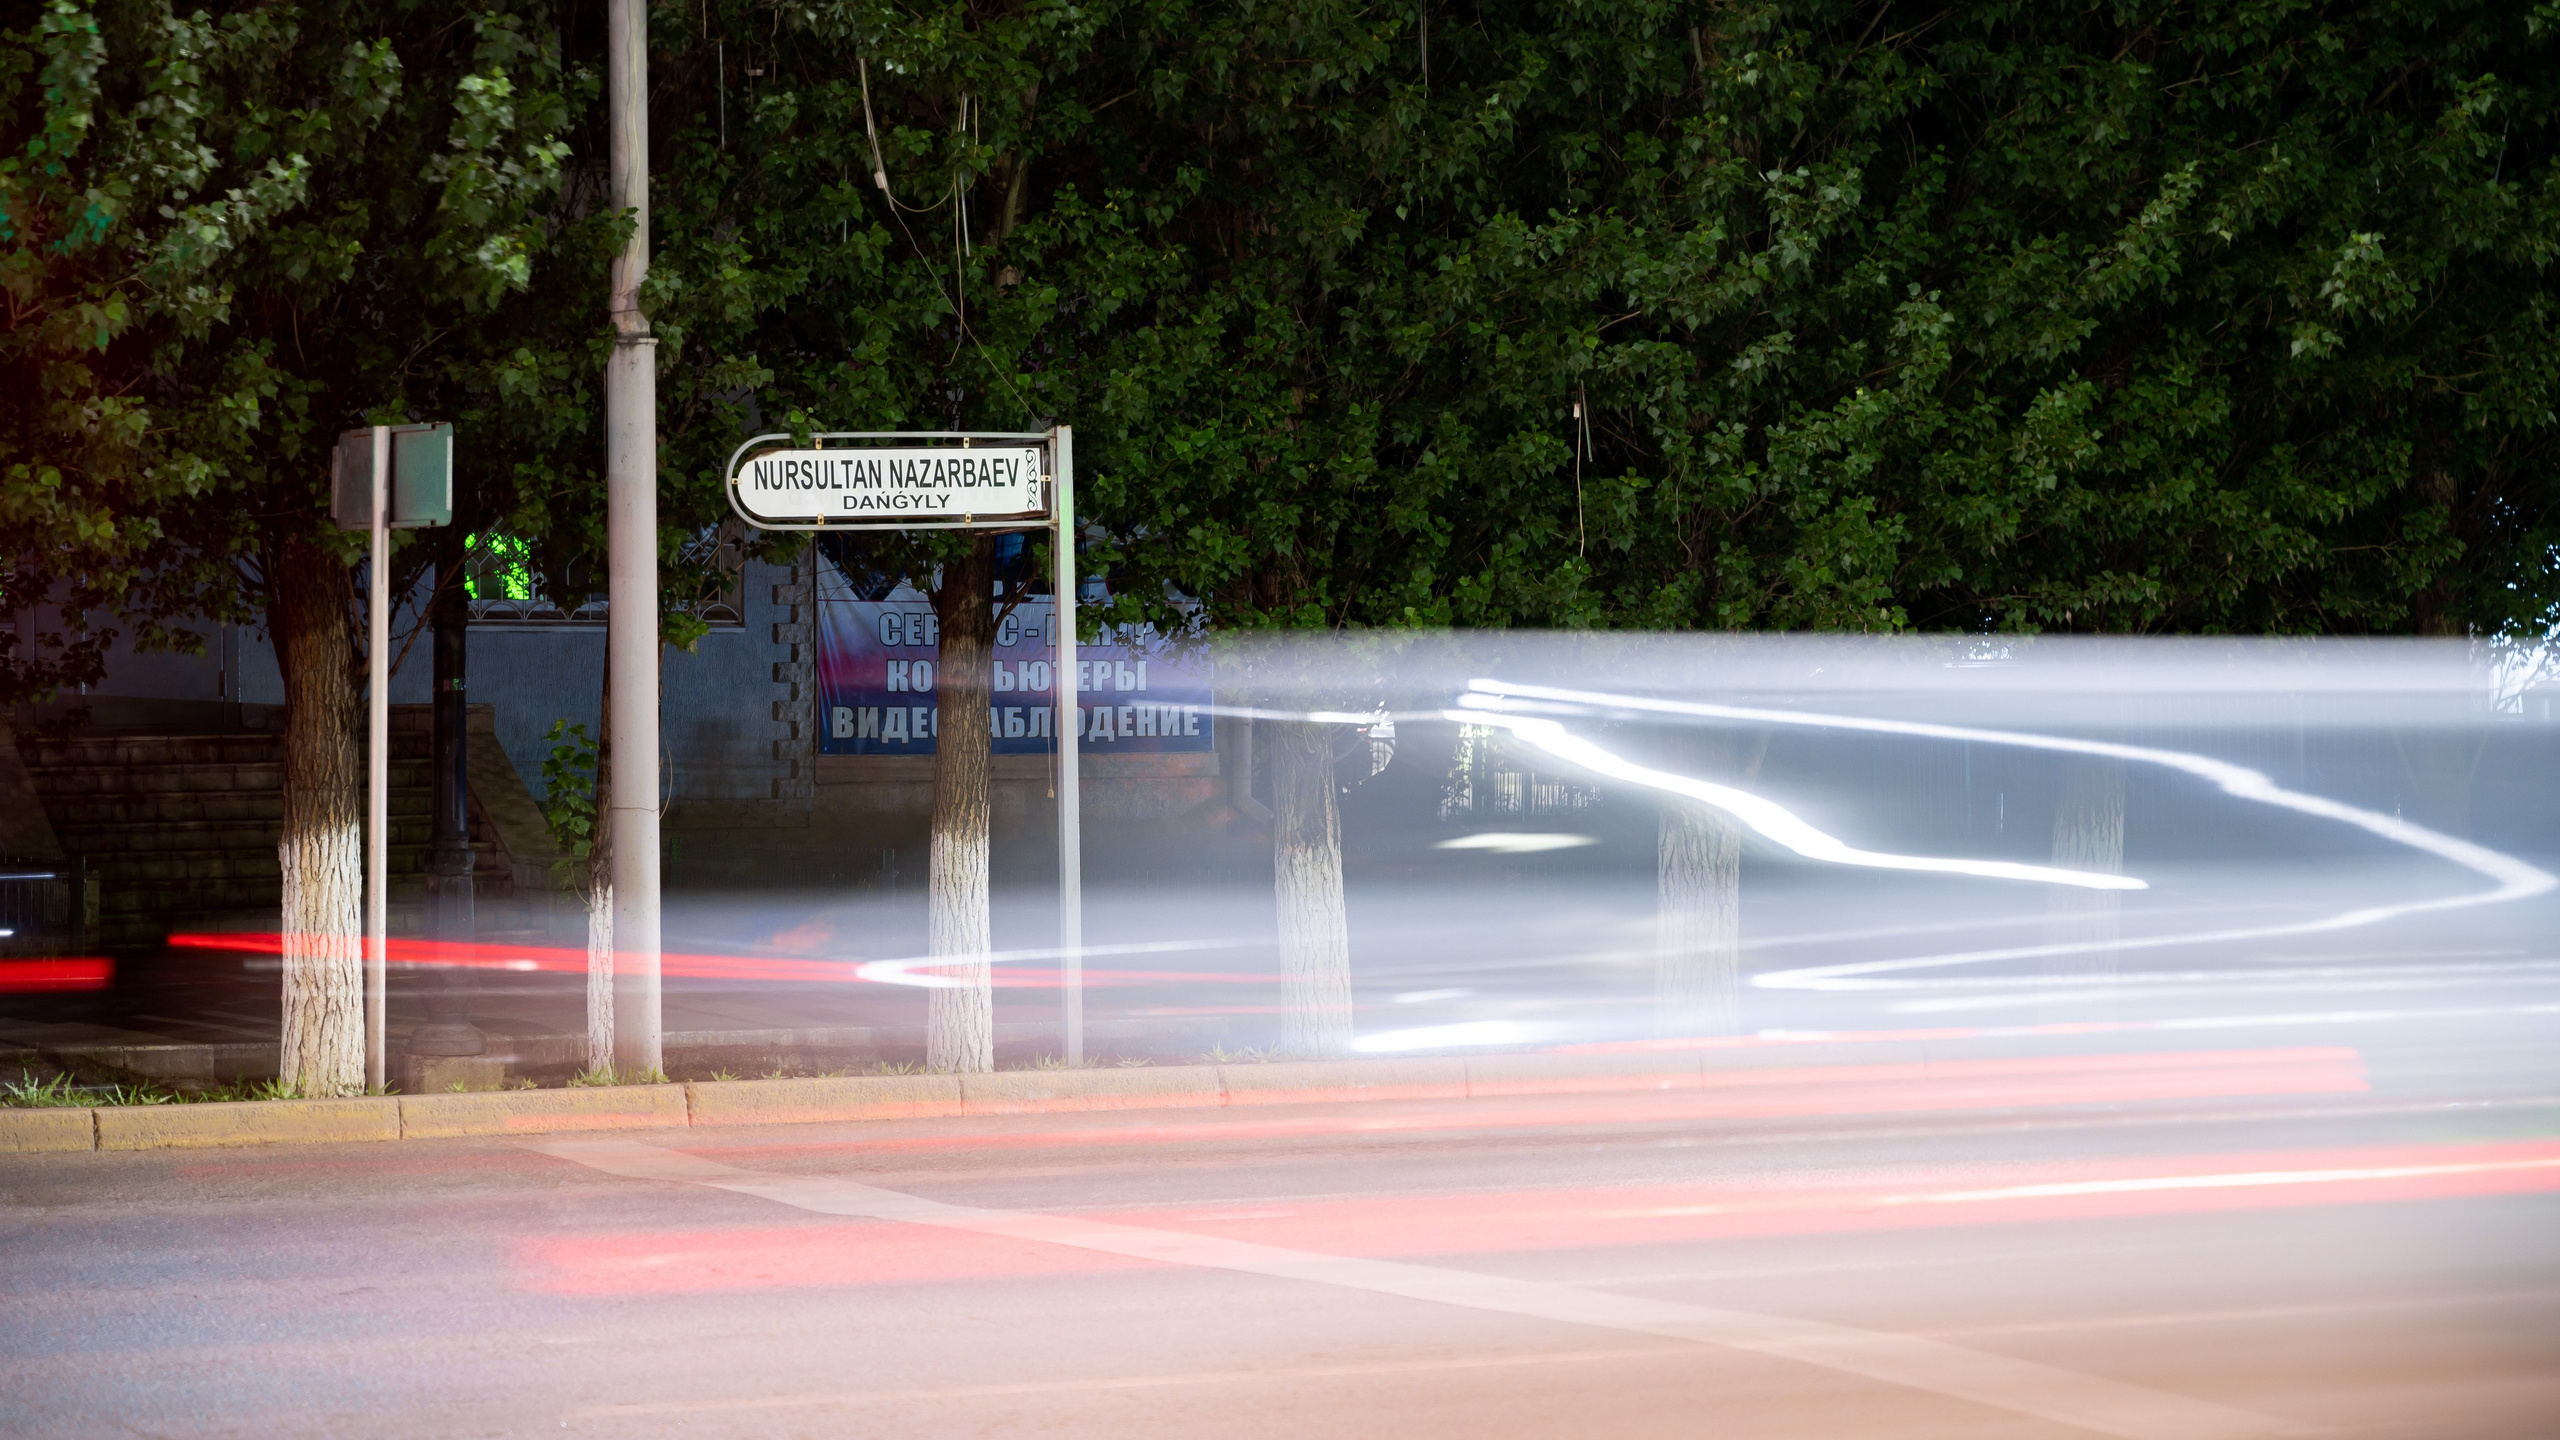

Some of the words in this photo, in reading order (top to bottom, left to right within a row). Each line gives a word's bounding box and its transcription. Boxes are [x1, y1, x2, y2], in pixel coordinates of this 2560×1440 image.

[754, 460, 882, 490] NURSULTAN
[890, 458, 1019, 489] NAZARBAEV
[843, 491, 951, 510] DAŃǴYLY
[887, 659, 1147, 693] КОЬЮЕРЫ
[832, 706, 1200, 743] ВИДЕАБЛДЕНИЕ
